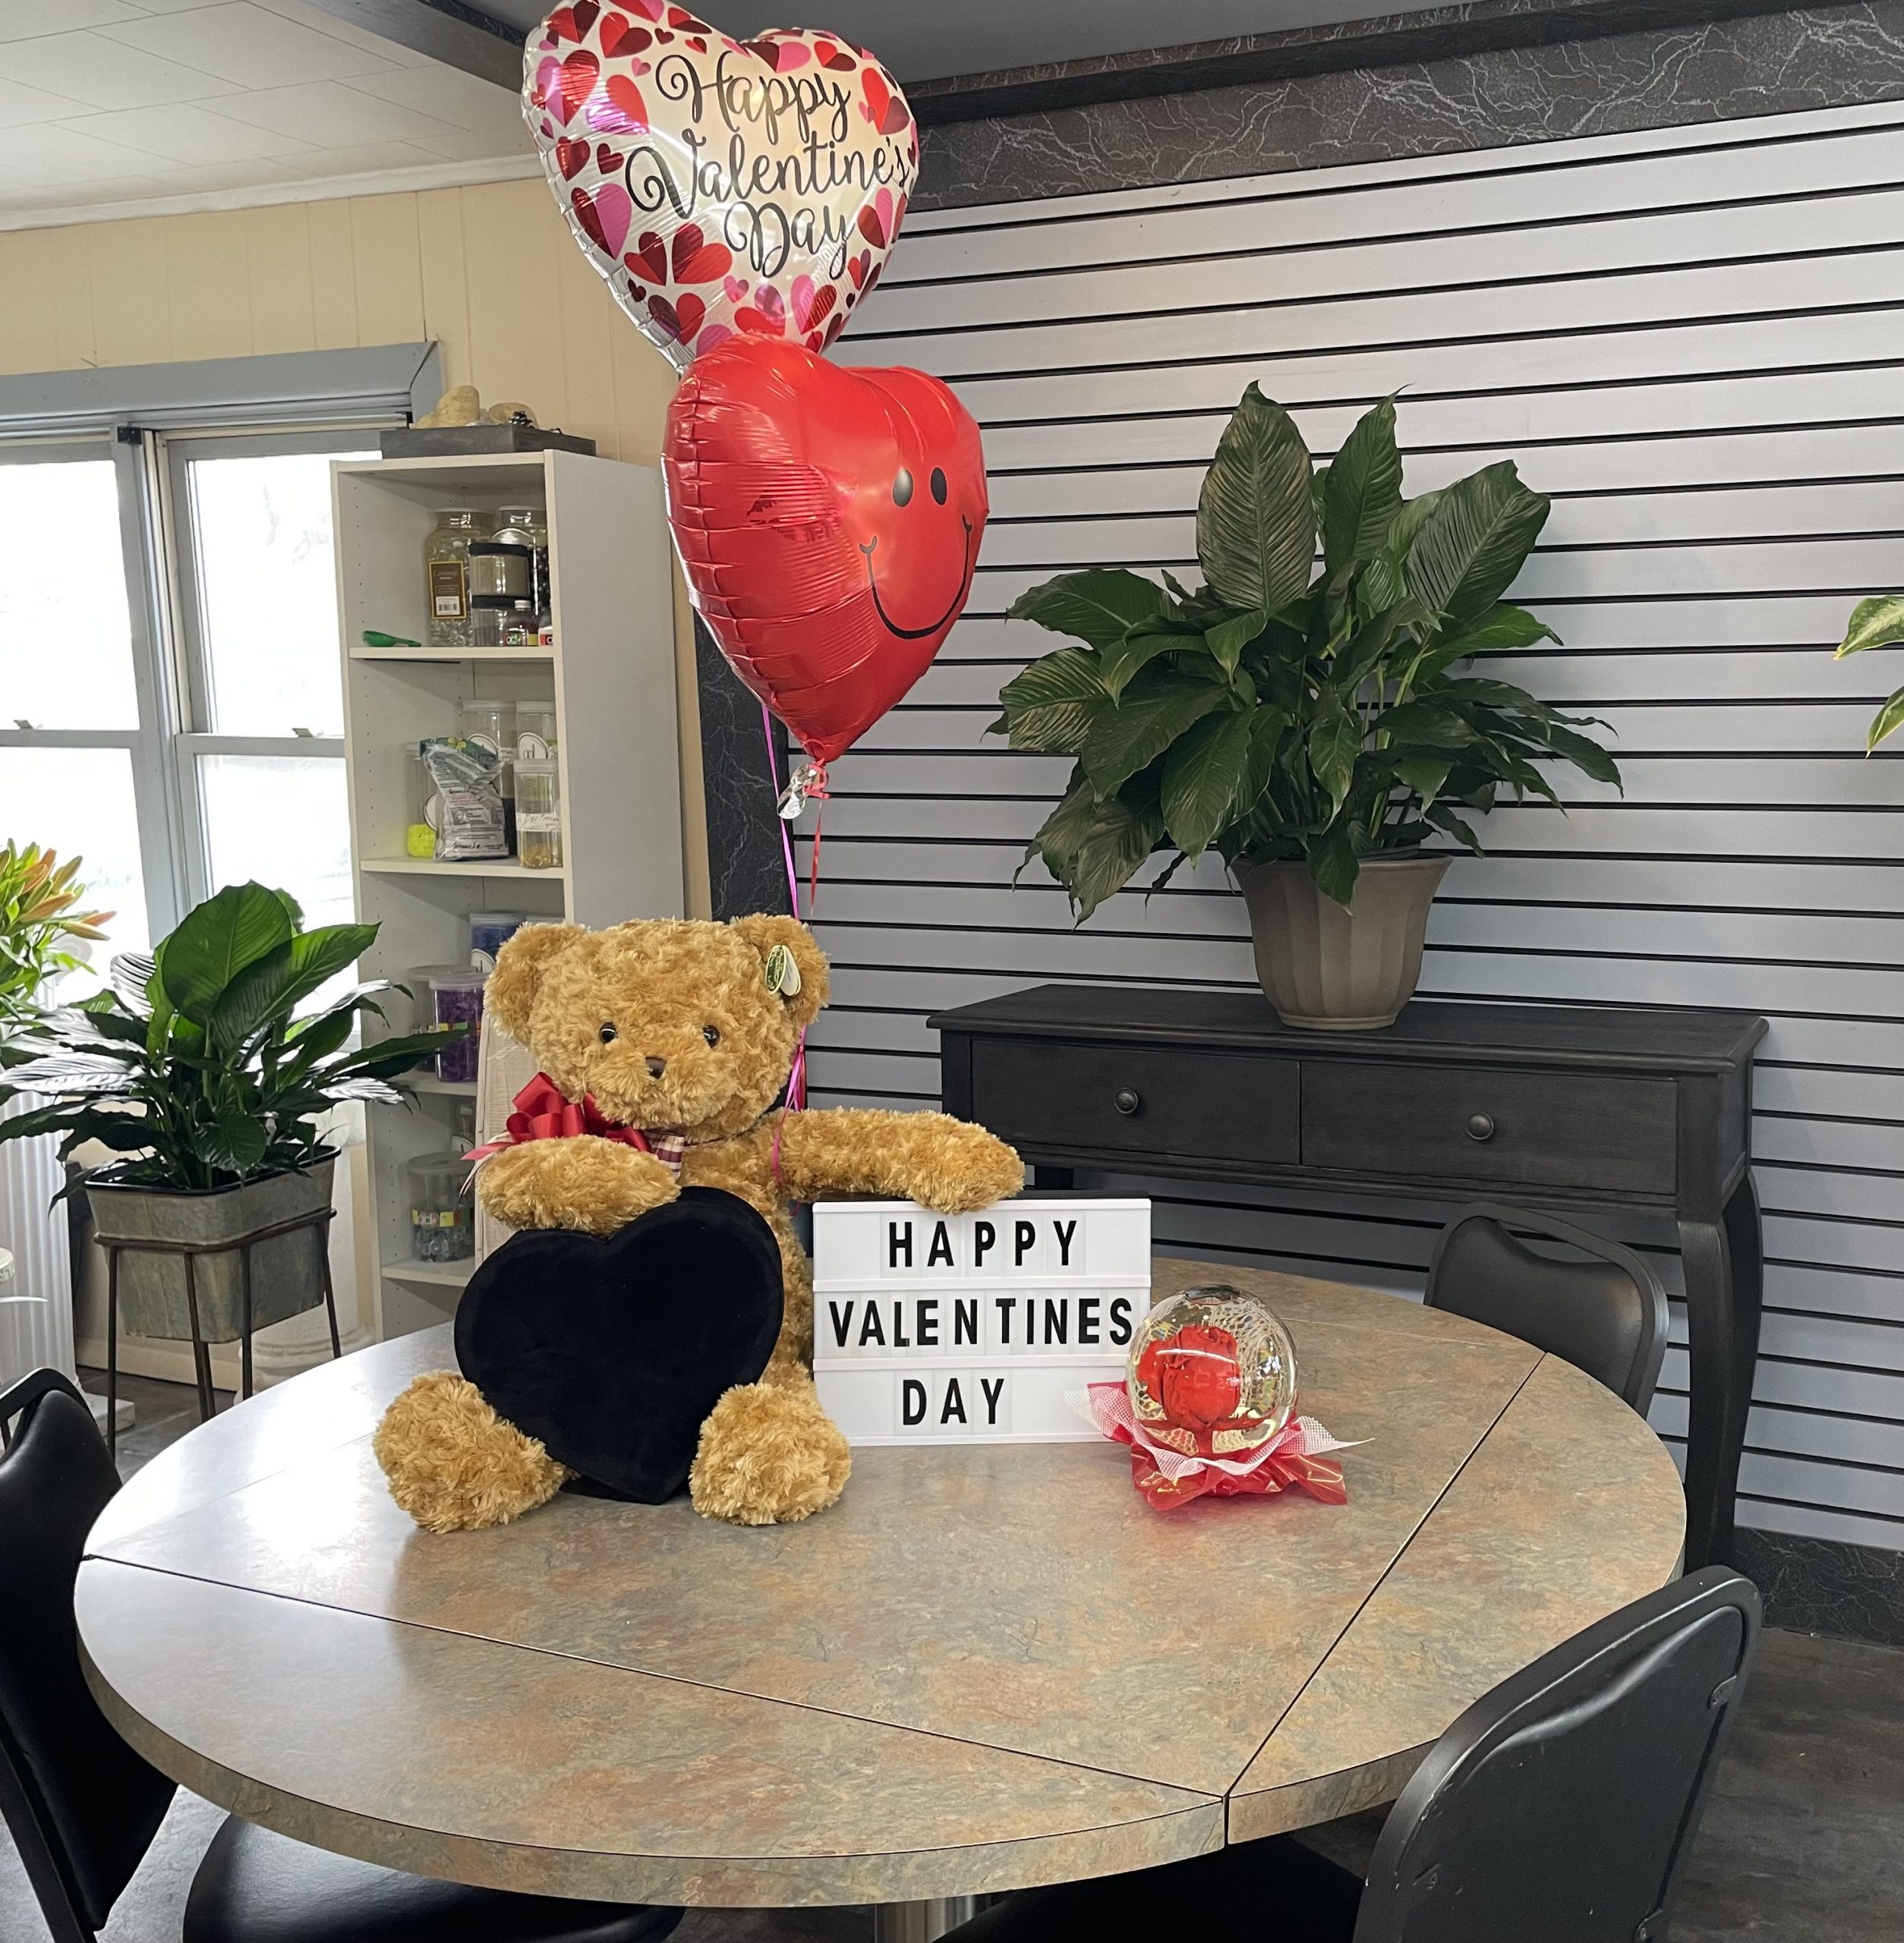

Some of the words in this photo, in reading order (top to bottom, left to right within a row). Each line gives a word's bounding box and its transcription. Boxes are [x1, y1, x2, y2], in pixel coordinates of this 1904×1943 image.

[655, 51, 850, 145] Happy
[625, 128, 909, 219] Valentine's
[723, 201, 856, 279] Day
[888, 1220, 1077, 1268] HAPPY
[828, 1298, 1132, 1347] VALENTINES
[902, 1378, 1004, 1425] DAY
